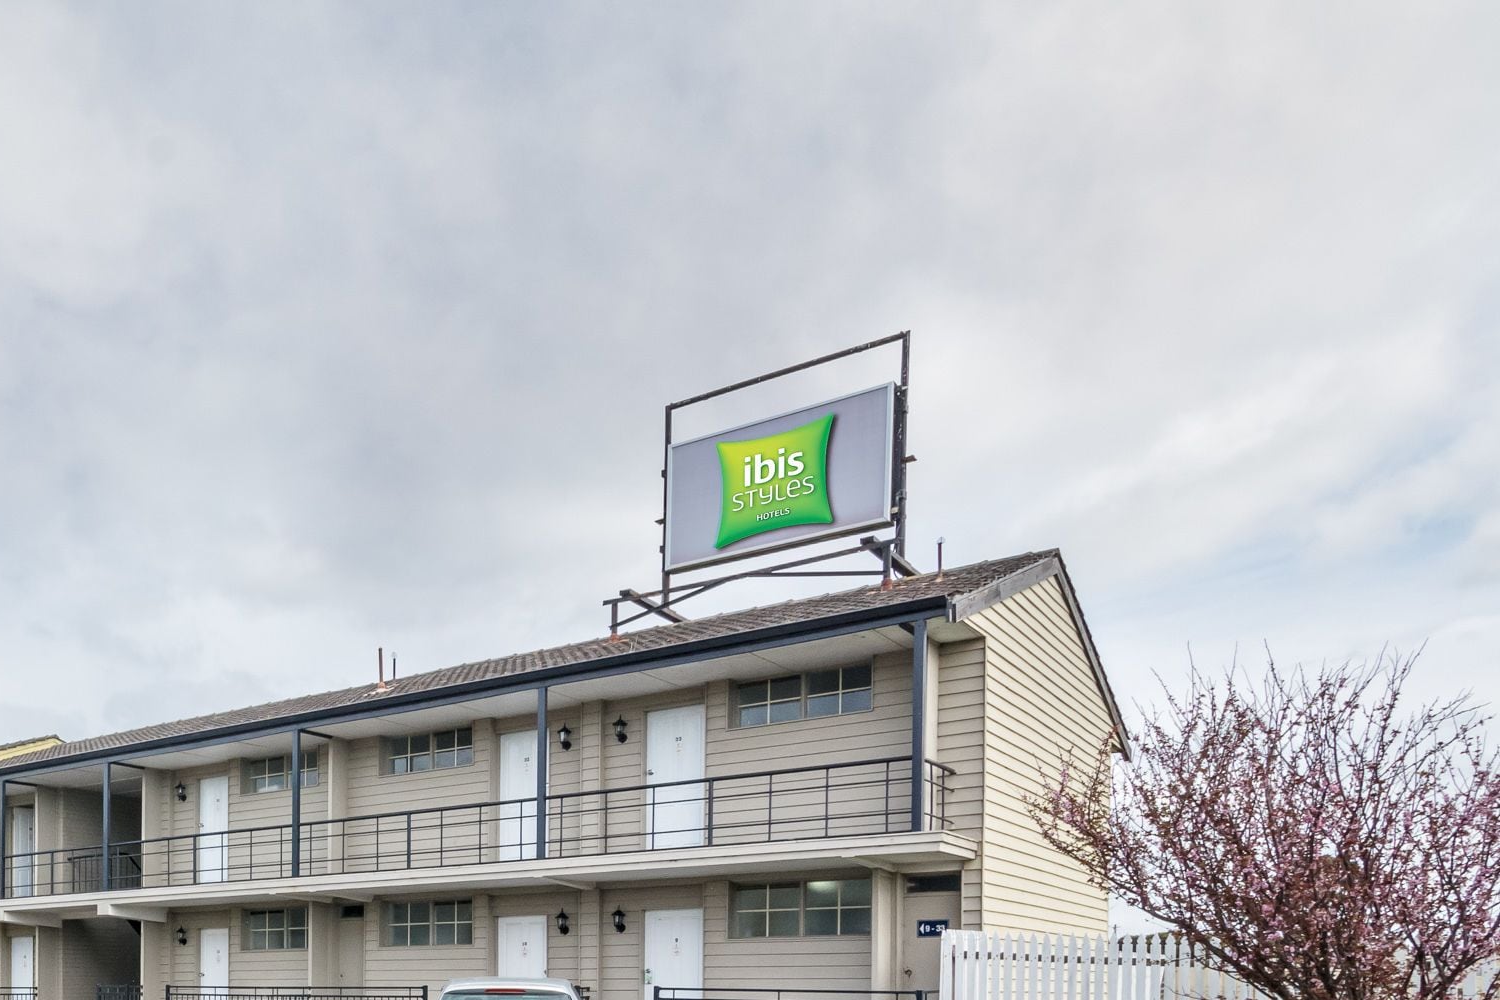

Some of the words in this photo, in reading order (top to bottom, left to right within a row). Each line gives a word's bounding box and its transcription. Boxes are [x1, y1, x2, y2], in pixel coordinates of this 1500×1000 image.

[743, 447, 805, 487] ibis
[756, 507, 790, 522] HOTELS
[925, 925, 930, 933] 9
